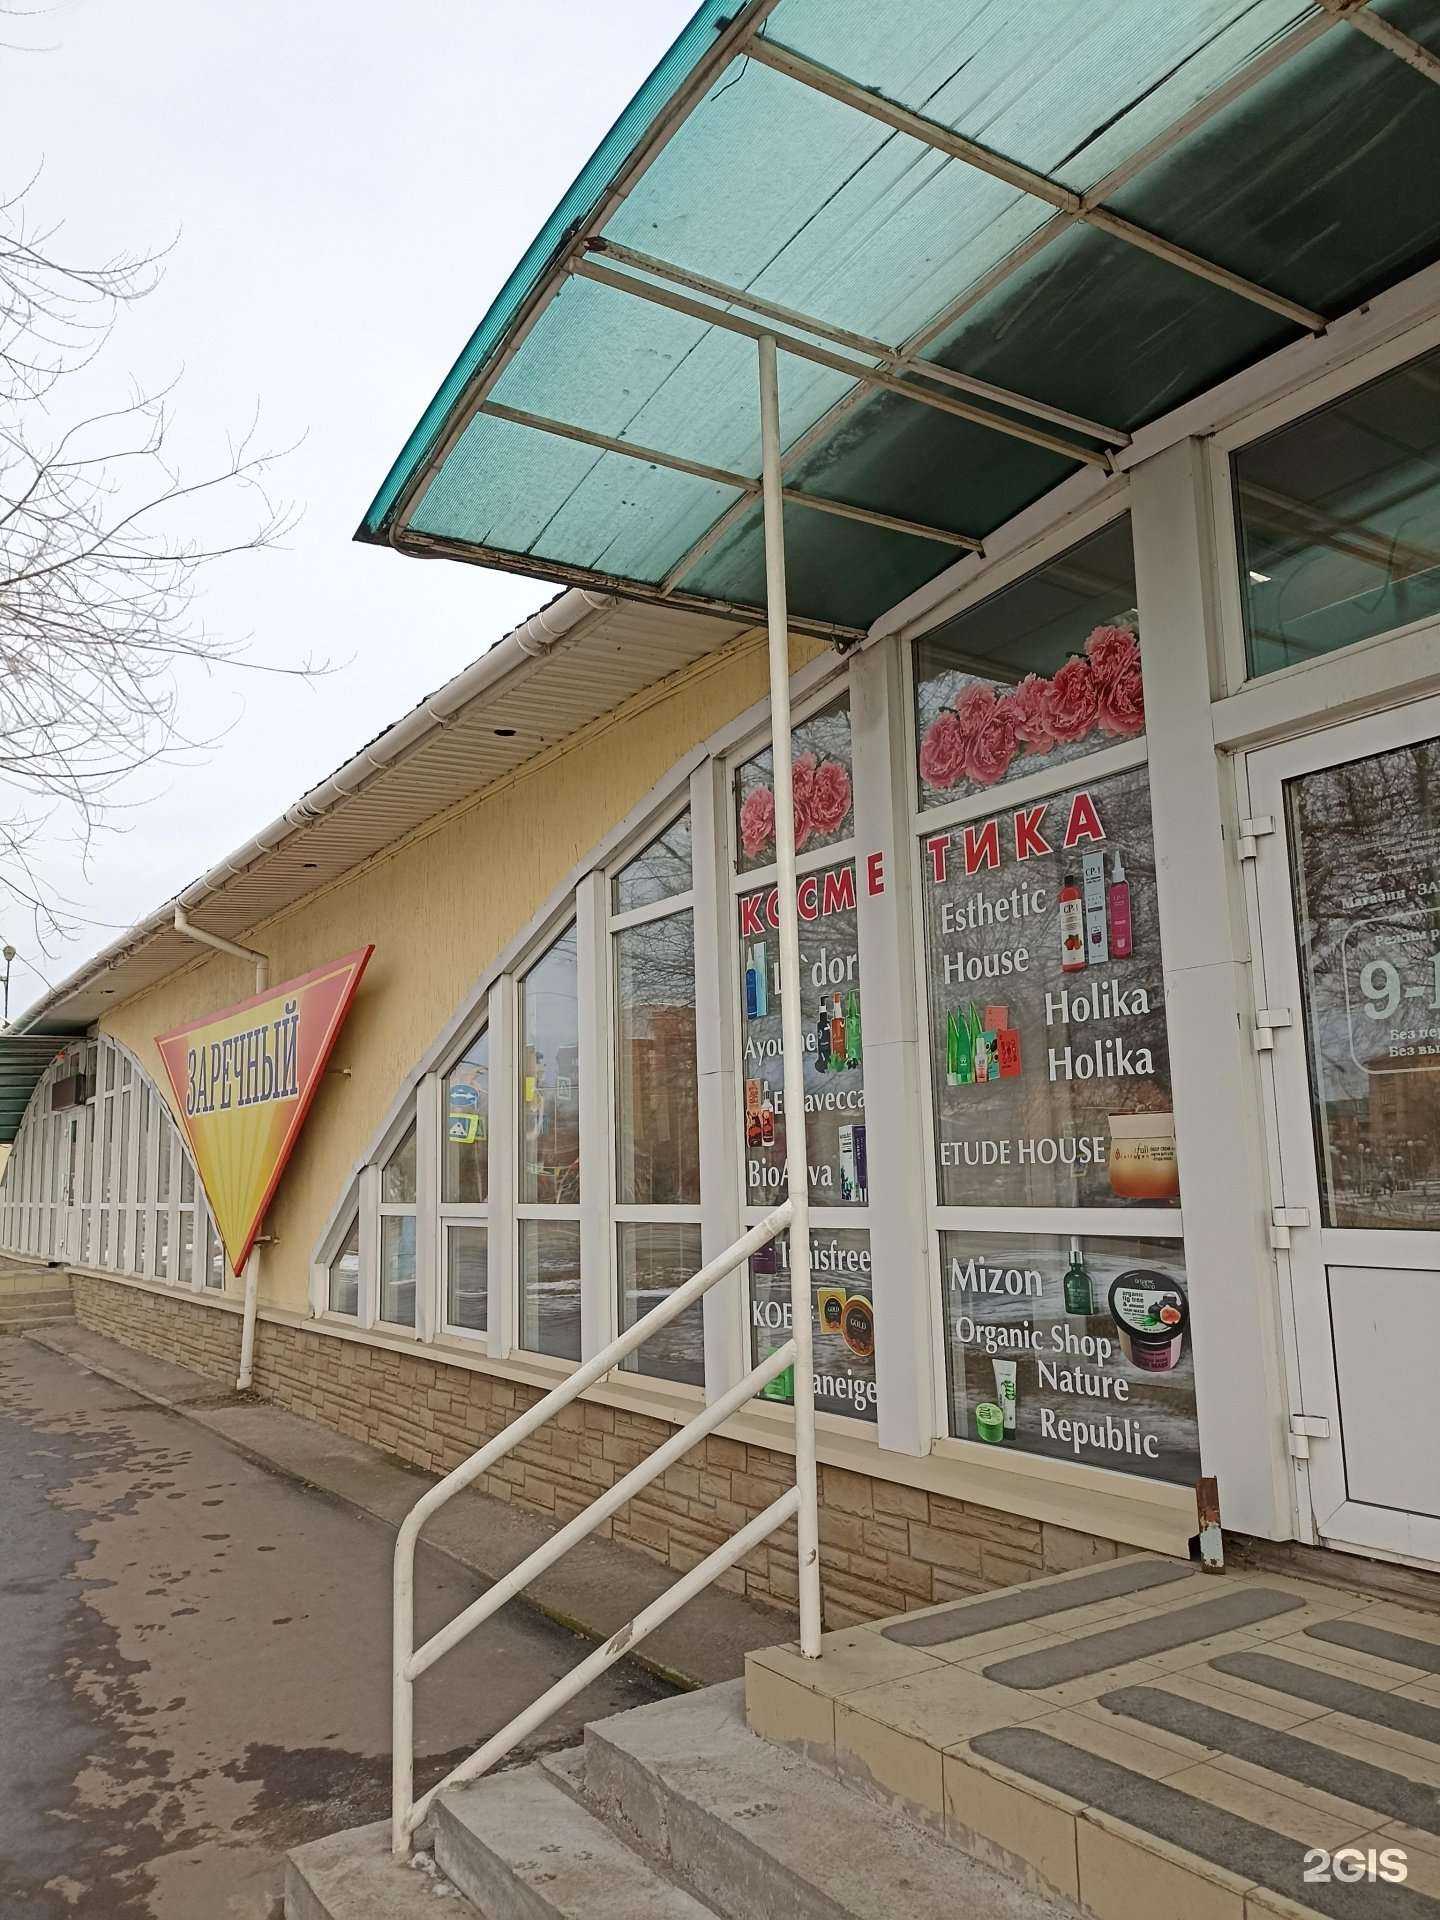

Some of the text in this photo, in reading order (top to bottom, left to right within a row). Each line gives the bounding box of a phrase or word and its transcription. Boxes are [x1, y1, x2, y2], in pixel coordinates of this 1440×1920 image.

[941, 882, 1048, 934] Esthetic
[1375, 930, 1427, 946] Режим
[943, 946, 1031, 985] House
[1045, 984, 1151, 1026] Holika
[1389, 1045, 1415, 1058] Без
[1390, 1029, 1416, 1041] Без
[186, 1000, 301, 1118] ЗАРЕЧНЫЙ
[1048, 1041, 1155, 1082] Holika
[774, 1088, 866, 1116] Eavecca
[940, 1136, 1106, 1167] ETUDE HOUSE
[951, 1257, 1044, 1297] Mizon
[850, 1318, 867, 1330] GOLD
[955, 1315, 1043, 1354] Organic
[1051, 1324, 1112, 1368] Shop
[812, 1368, 879, 1411] aneige
[1038, 1359, 1129, 1401] Nature
[1040, 1407, 1160, 1459] Republic
